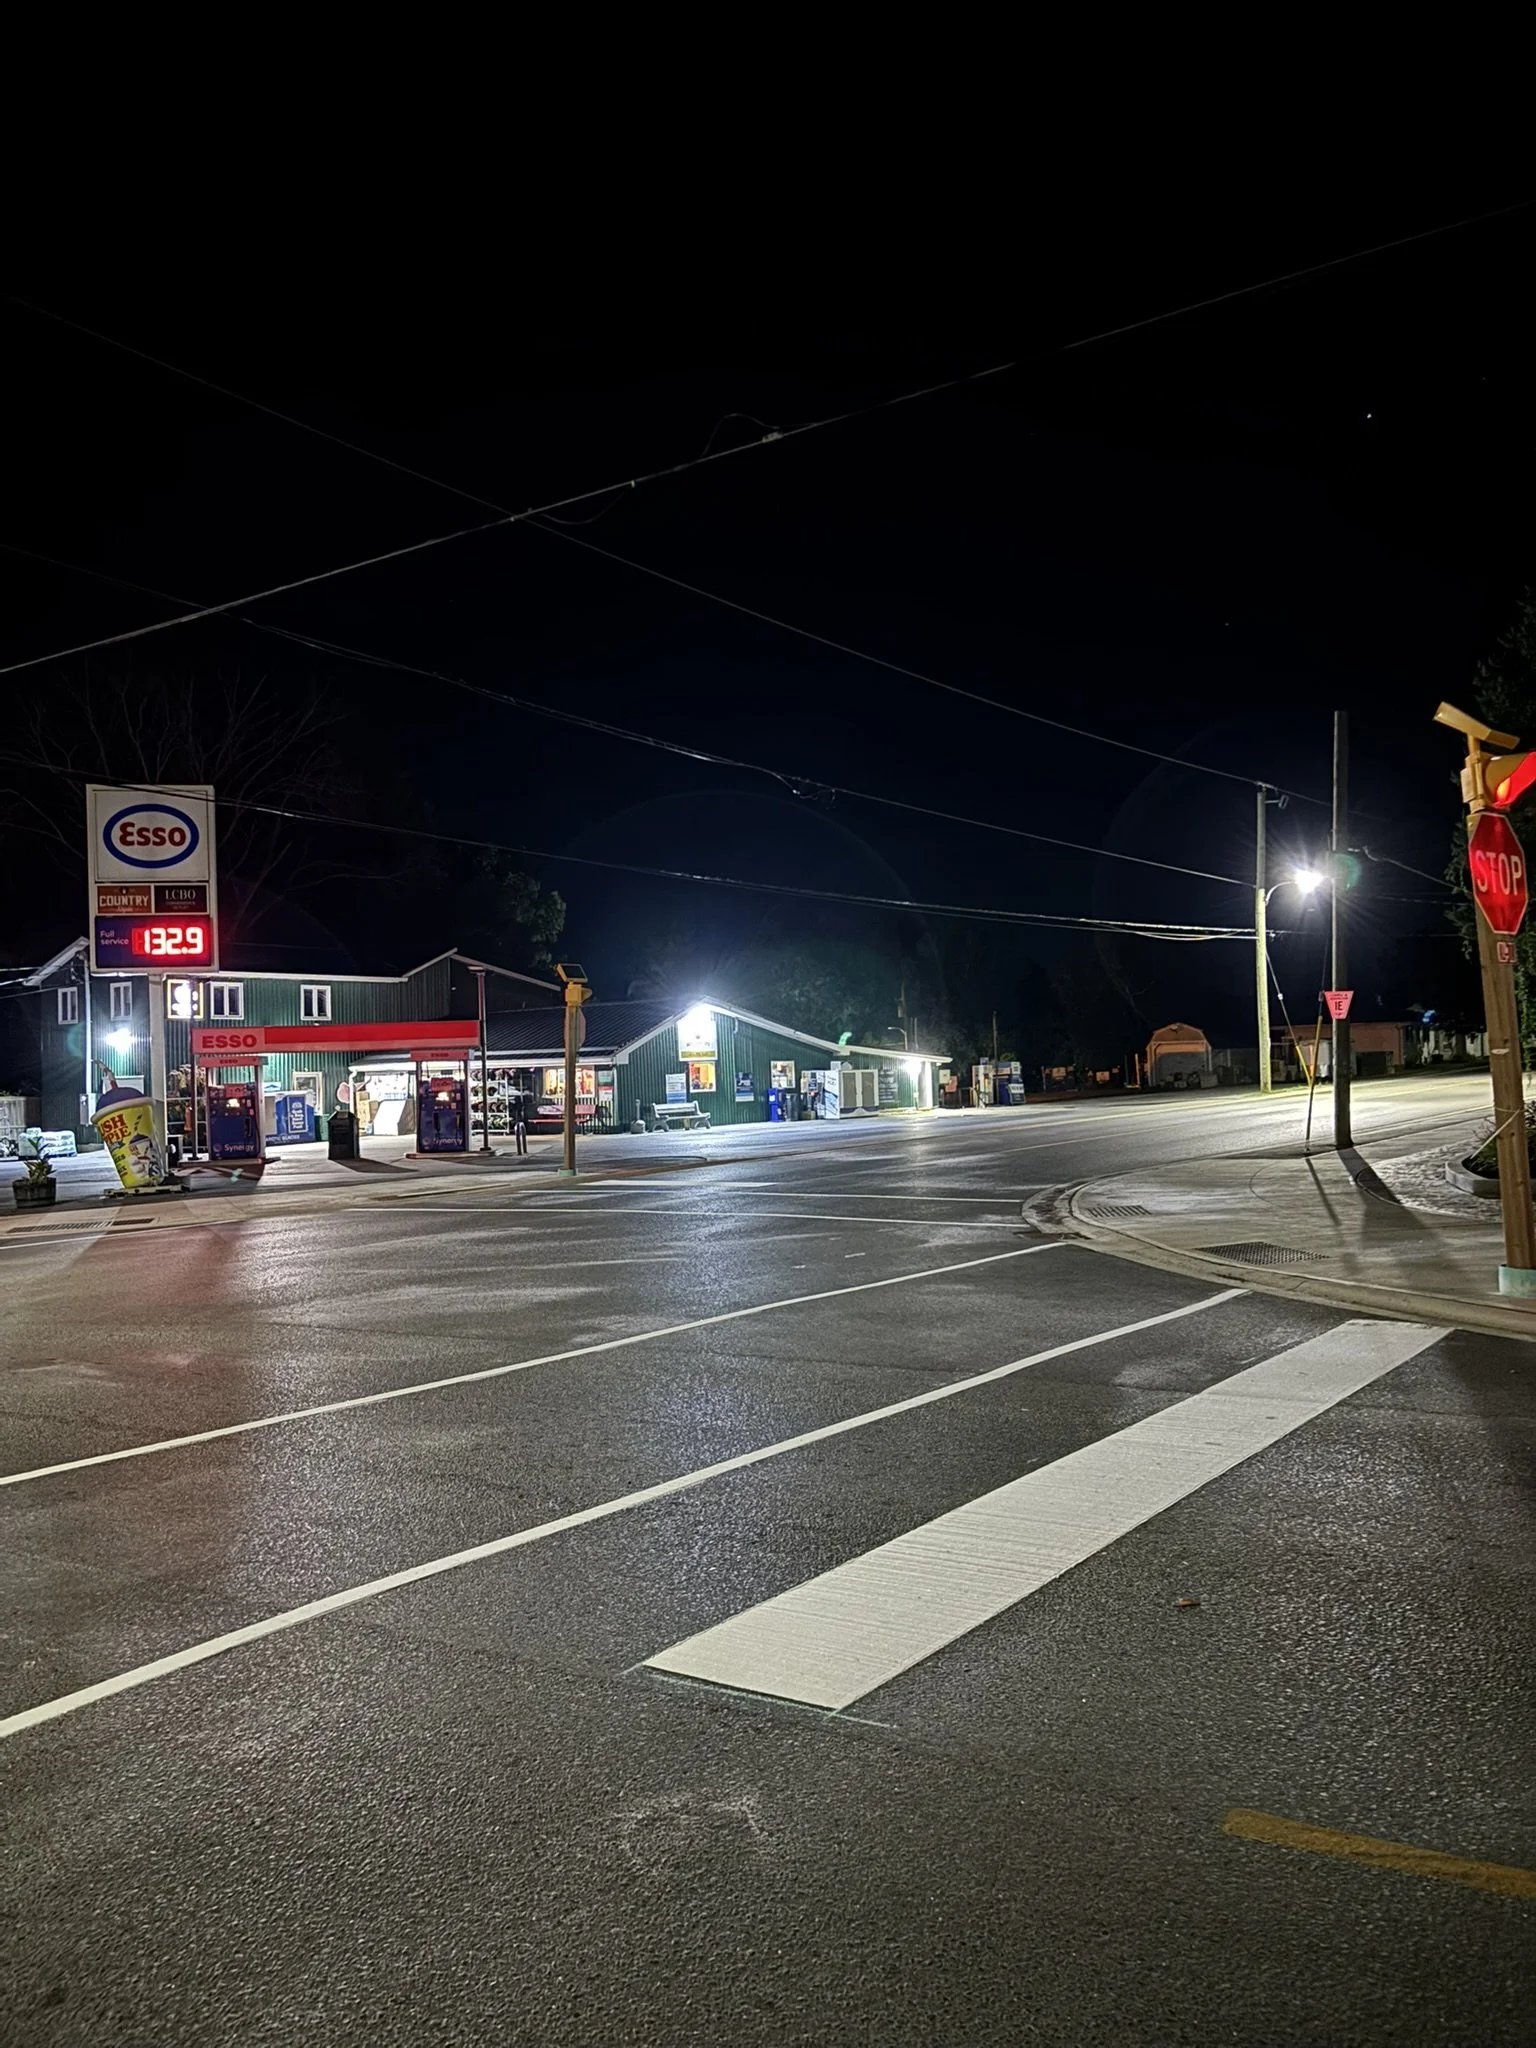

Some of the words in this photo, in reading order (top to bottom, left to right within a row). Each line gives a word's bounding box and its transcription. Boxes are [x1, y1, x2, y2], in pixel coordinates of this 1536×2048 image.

[119, 821, 186, 847] Esso
[1475, 850, 1522, 896] STOP
[99, 895, 149, 907] COUNTRY
[165, 889, 196, 900] LCBO
[100, 930, 115, 938] Full
[144, 927, 203, 955] 132.9
[202, 1034, 257, 1049] ESSO
[224, 1143, 255, 1152] Synergy
